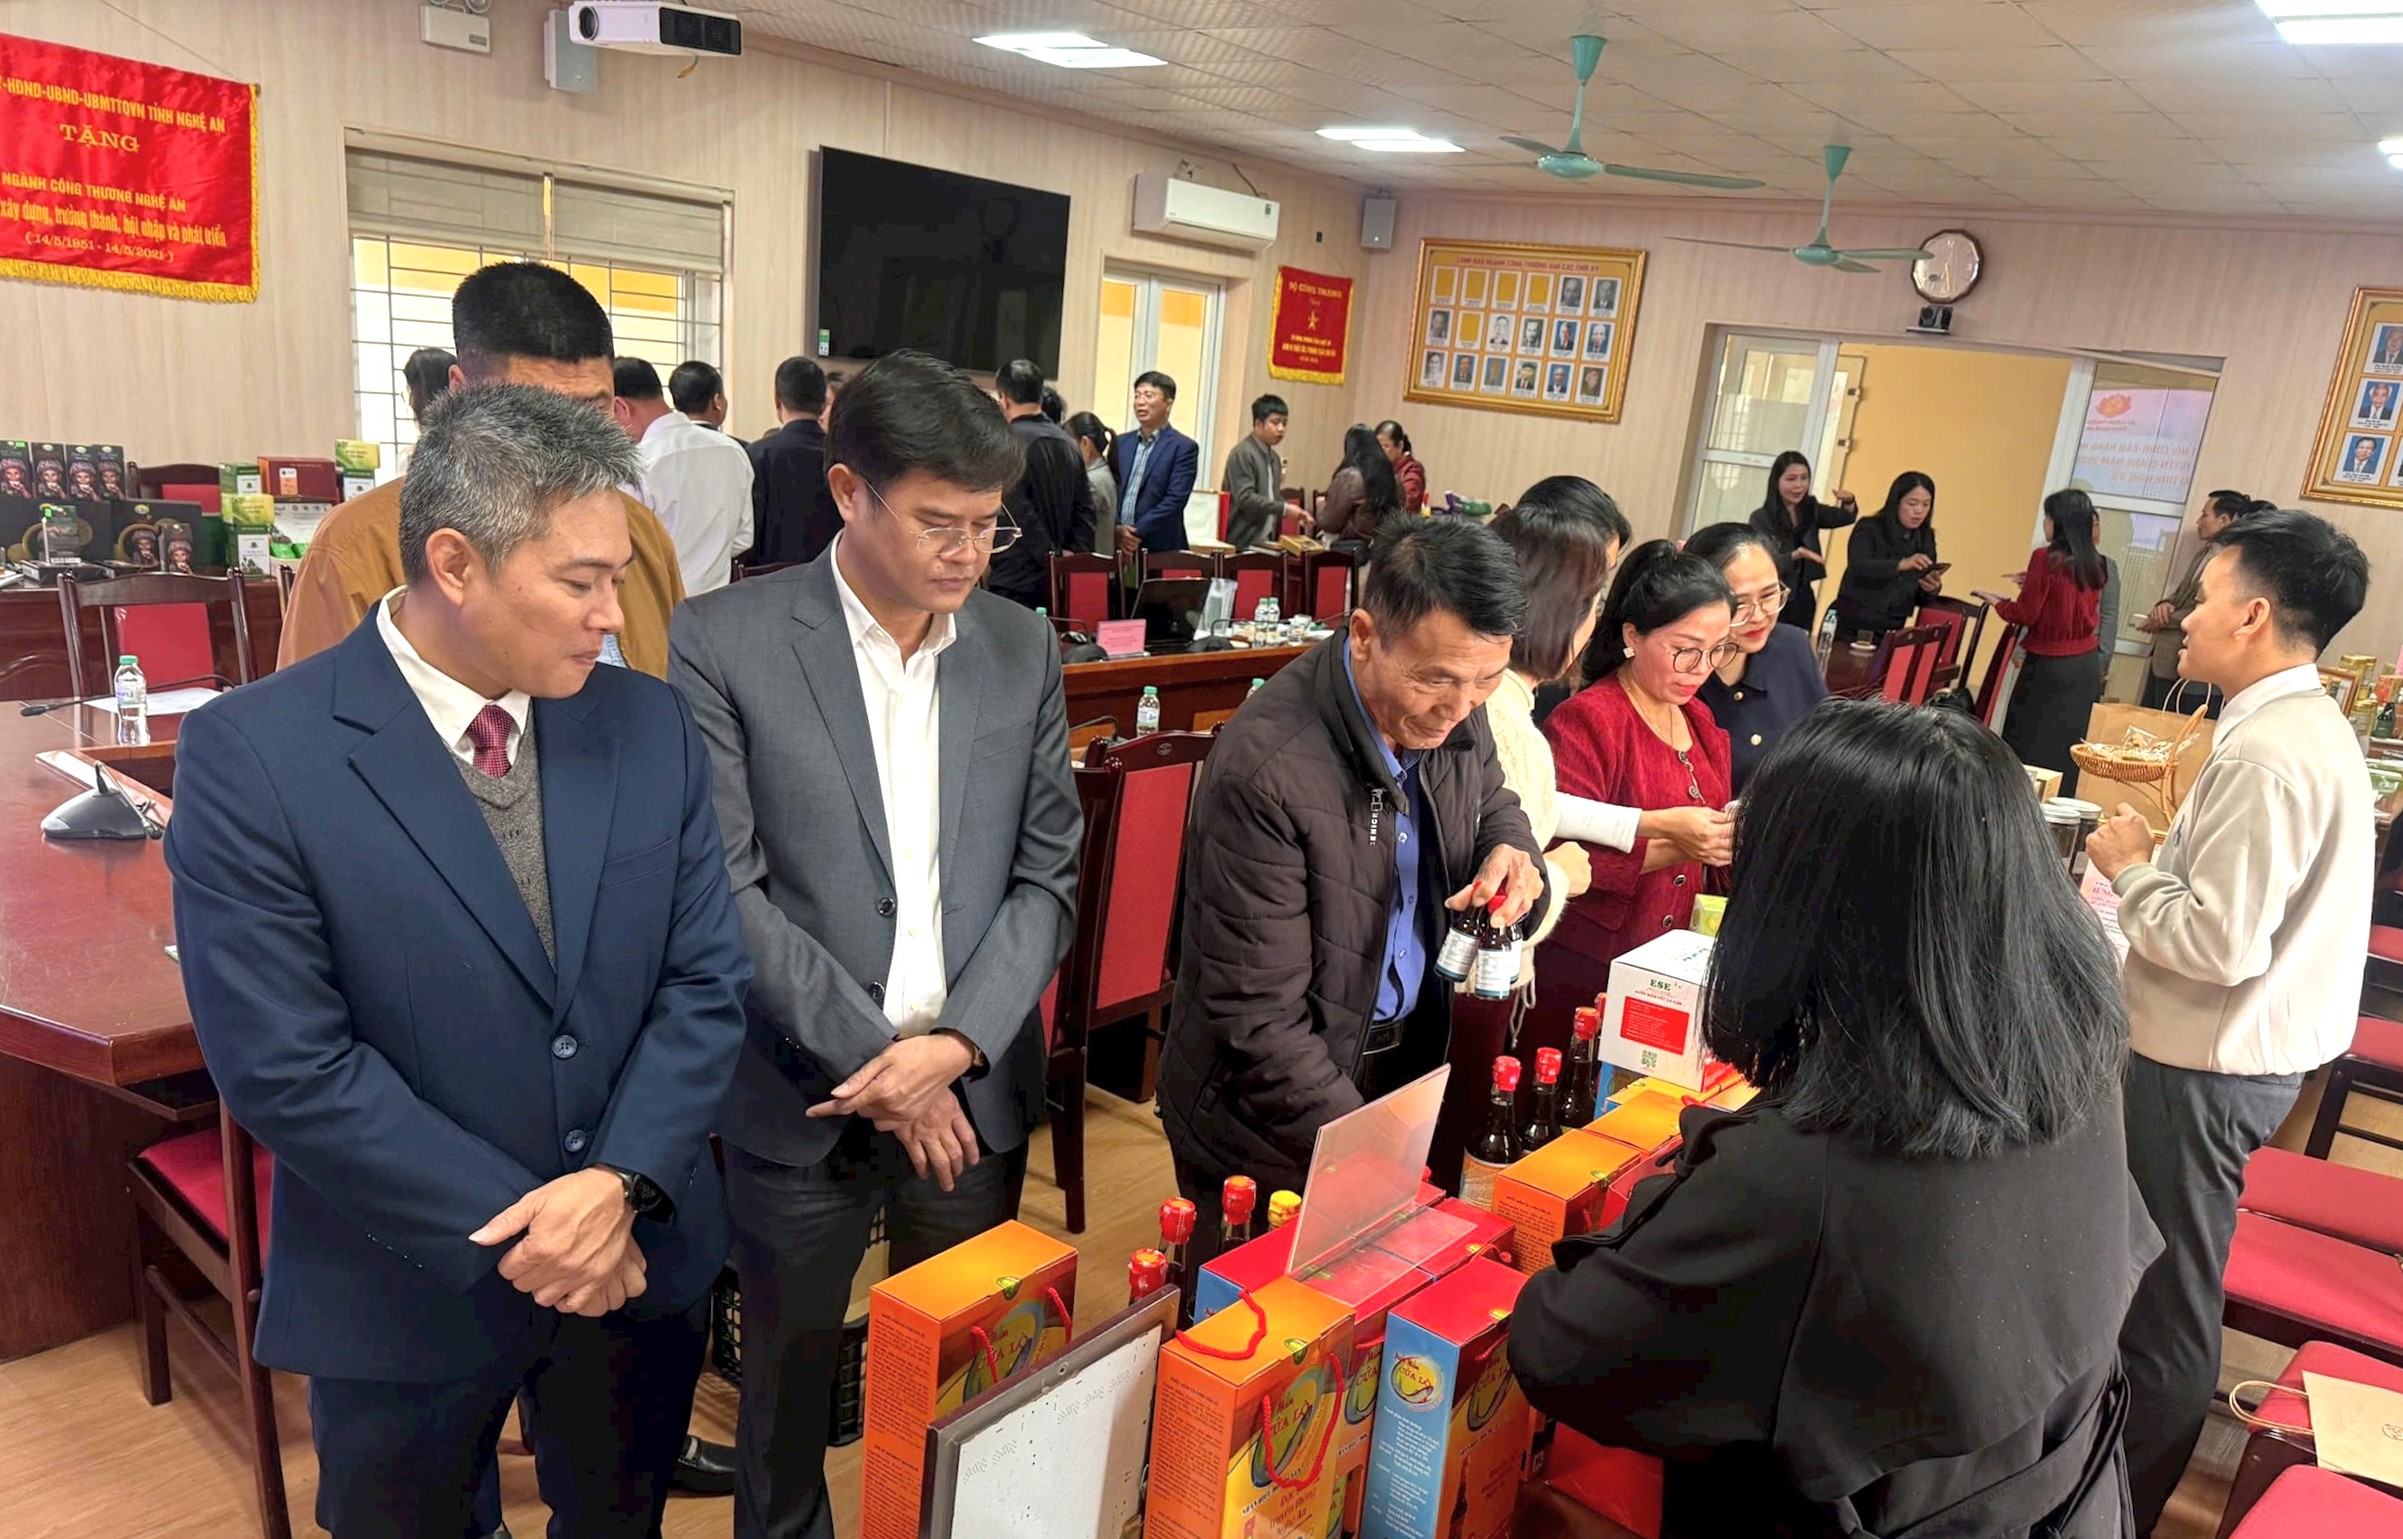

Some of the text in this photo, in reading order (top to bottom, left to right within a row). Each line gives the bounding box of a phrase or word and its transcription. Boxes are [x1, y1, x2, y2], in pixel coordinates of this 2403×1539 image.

[147, 103, 174, 124] TỈNH
[176, 112, 207, 132] NGHỆ
[209, 117, 226, 133] AN
[59, 124, 140, 153] TẶNG
[2, 171, 186, 212] NGÀNH CÔNG THƯƠNG NGHỆ AN
[55, 204, 87, 229] trưởng
[123, 215, 139, 237] hội
[141, 219, 165, 242] nhập
[168, 223, 180, 242] và
[182, 225, 203, 245] phát
[204, 224, 226, 247] triển
[1650, 979, 1671, 991] ESE
